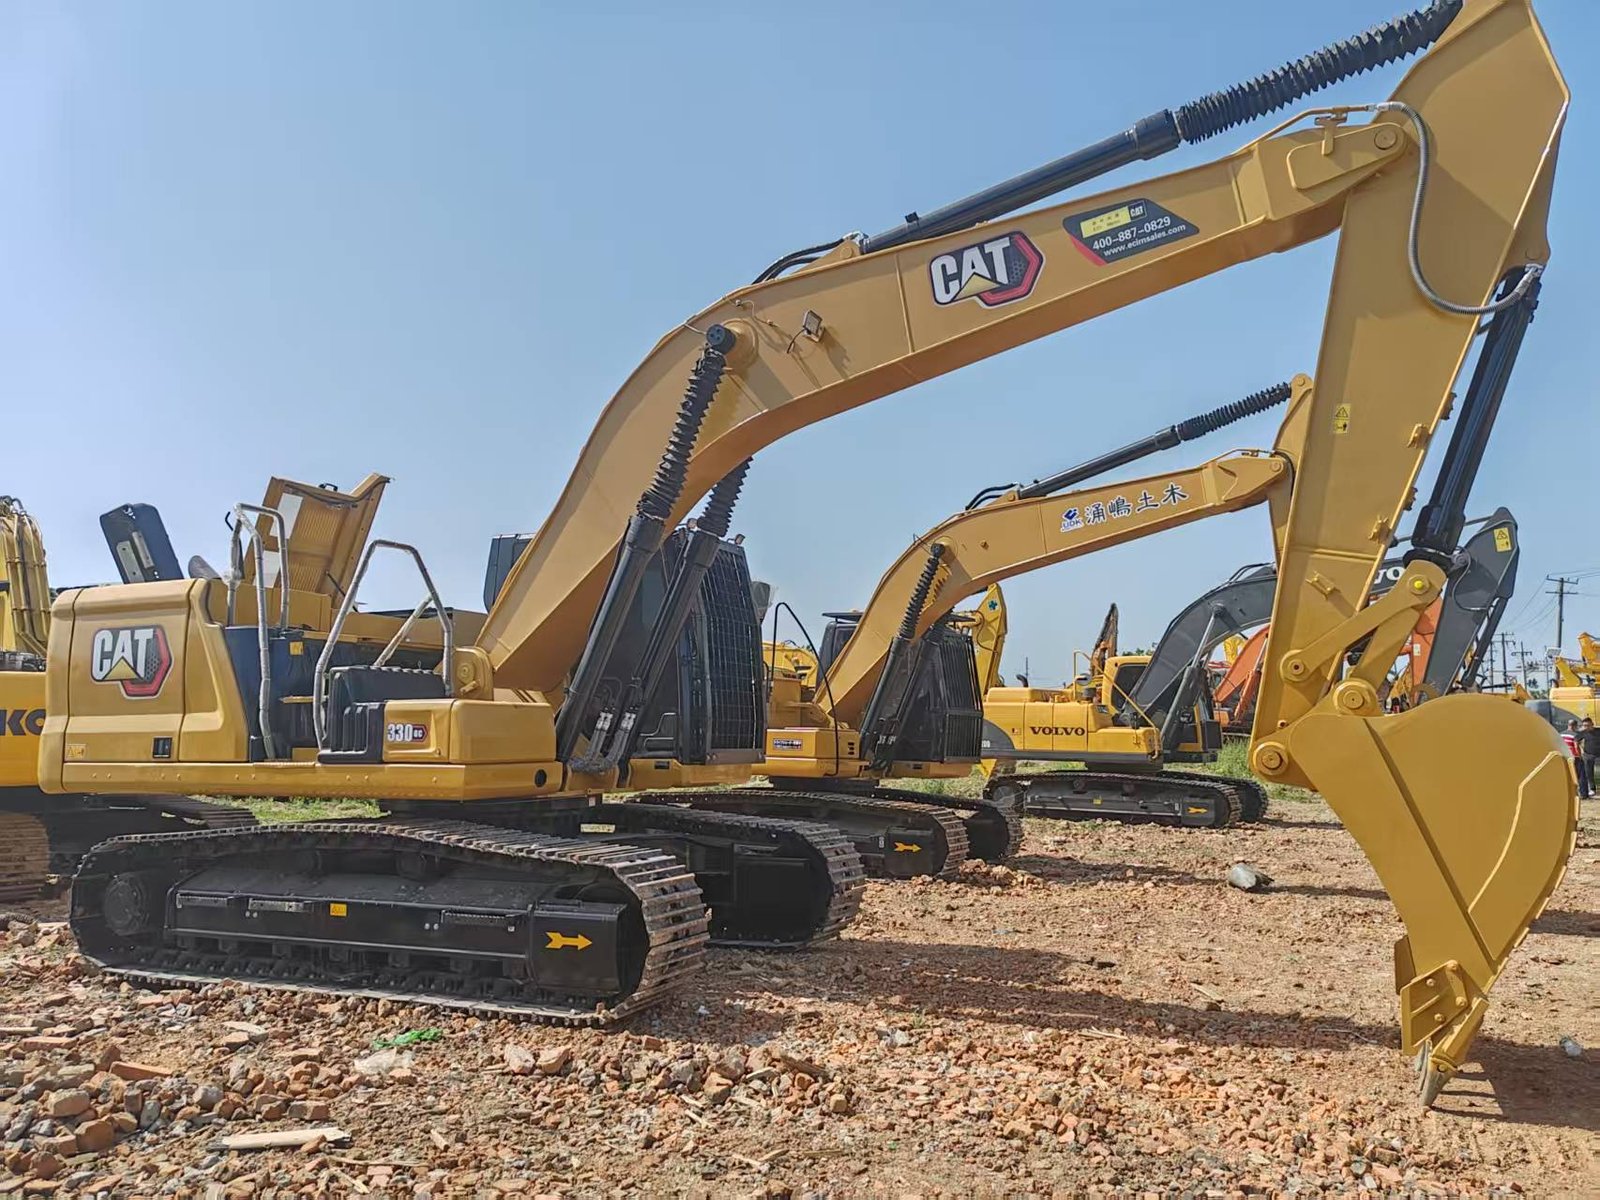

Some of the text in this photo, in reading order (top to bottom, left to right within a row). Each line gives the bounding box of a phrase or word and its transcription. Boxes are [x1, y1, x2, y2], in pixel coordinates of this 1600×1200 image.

[1130, 206, 1144, 218] CAT
[1093, 216, 1171, 250] 400-887-0829
[1103, 224, 1187, 257] www.ecimsales.com
[931, 236, 1011, 304] CAT
[92, 628, 155, 680] CAT
[387, 723, 413, 742] 330
[1030, 726, 1086, 737] VOLVO
